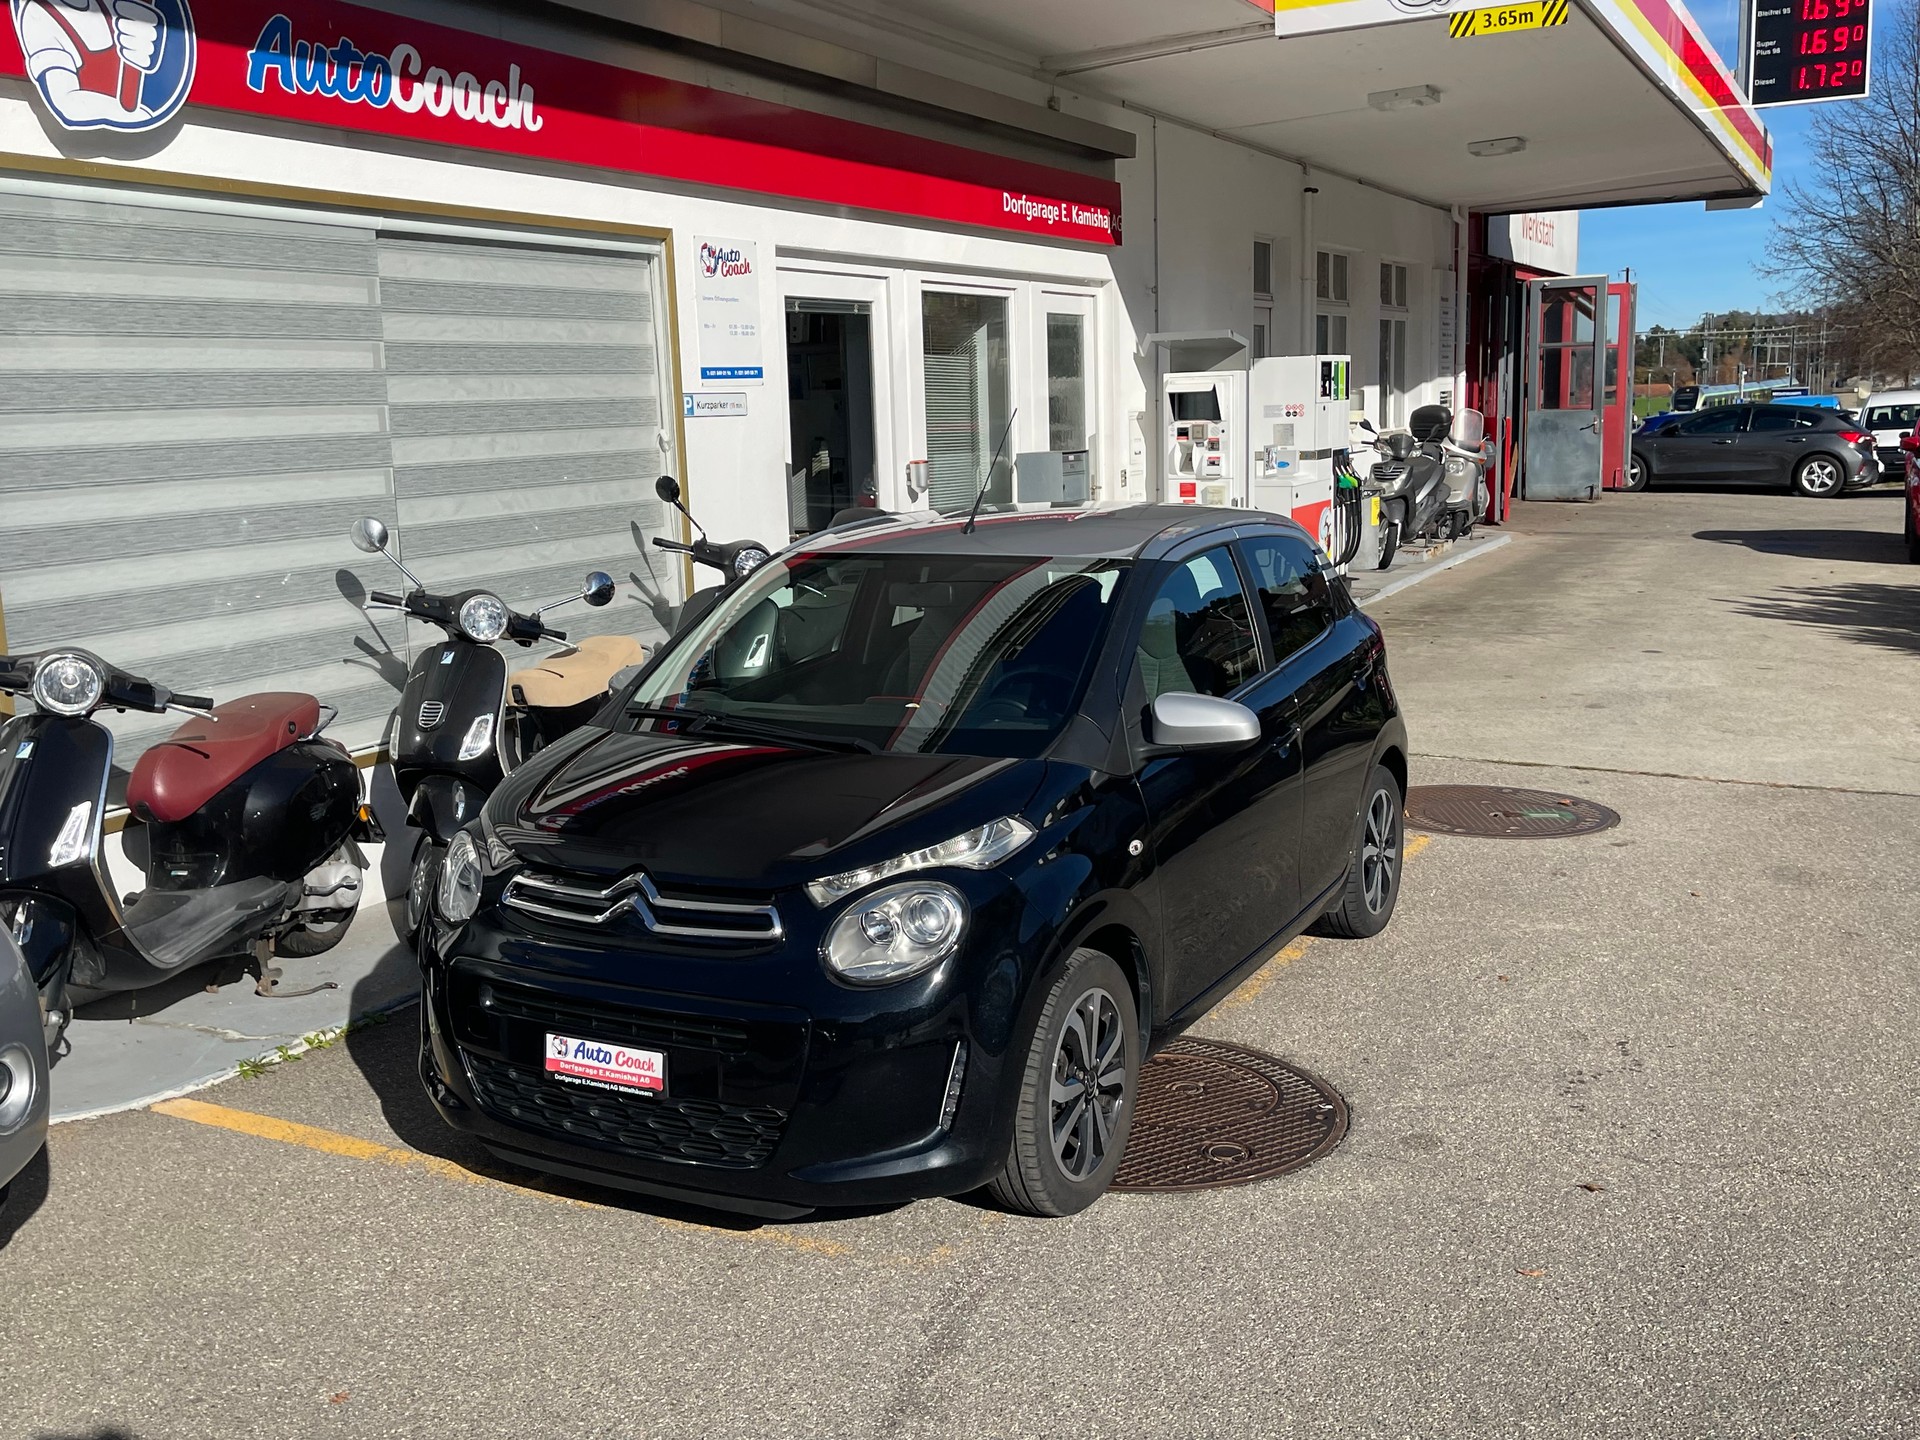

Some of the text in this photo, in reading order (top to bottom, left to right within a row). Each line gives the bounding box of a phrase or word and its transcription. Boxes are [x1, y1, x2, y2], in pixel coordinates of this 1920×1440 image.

[1483, 10, 1534, 29] 3.65m
[1756, 40, 1777, 48] Super
[1756, 48, 1771, 56] Plus
[1754, 78, 1776, 86] Diesel
[1003, 192, 1059, 225] Dorfgarage
[1061, 203, 1070, 222] E.
[1072, 205, 1111, 234] Kamishaj
[1521, 213, 1555, 247] Werkstatt
[717, 248, 741, 265] Auto
[721, 258, 752, 277] Coach
[696, 400, 728, 411] Kurzparker
[574, 1041, 656, 1073] Auto Coach
[554, 1073, 582, 1084] Dorfgarage
[560, 1062, 598, 1075] Dorfgarage
[639, 1076, 650, 1084] AG
